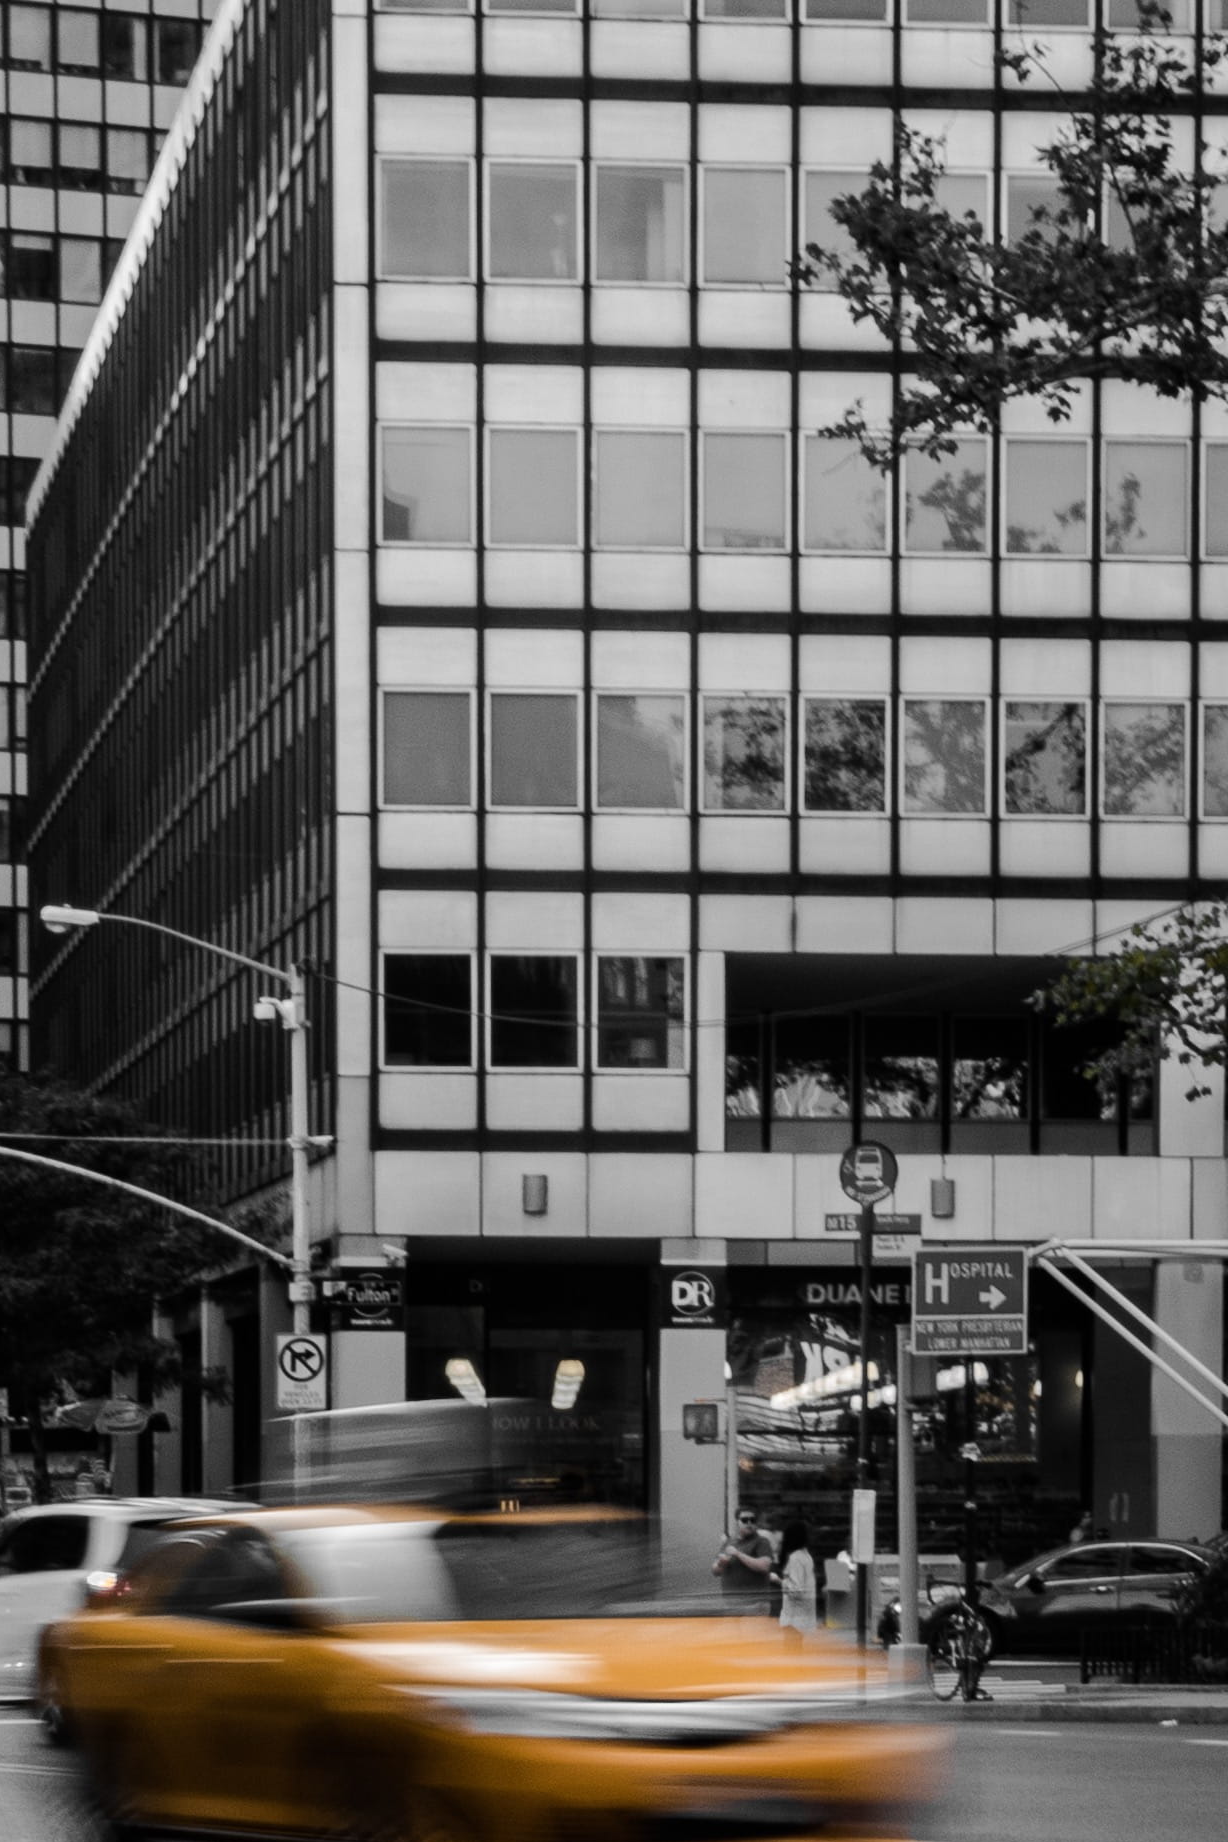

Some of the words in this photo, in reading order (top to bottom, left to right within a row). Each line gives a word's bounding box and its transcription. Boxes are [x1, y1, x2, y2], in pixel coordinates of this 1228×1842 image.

[826, 1216, 857, 1231] M15
[925, 1262, 1013, 1304] HOSPITAL
[348, 1287, 391, 1302] Fulton
[671, 1280, 714, 1307] DR
[806, 1283, 900, 1304] DUANE
[915, 1321, 934, 1334] NEW
[936, 1321, 959, 1334] YORK
